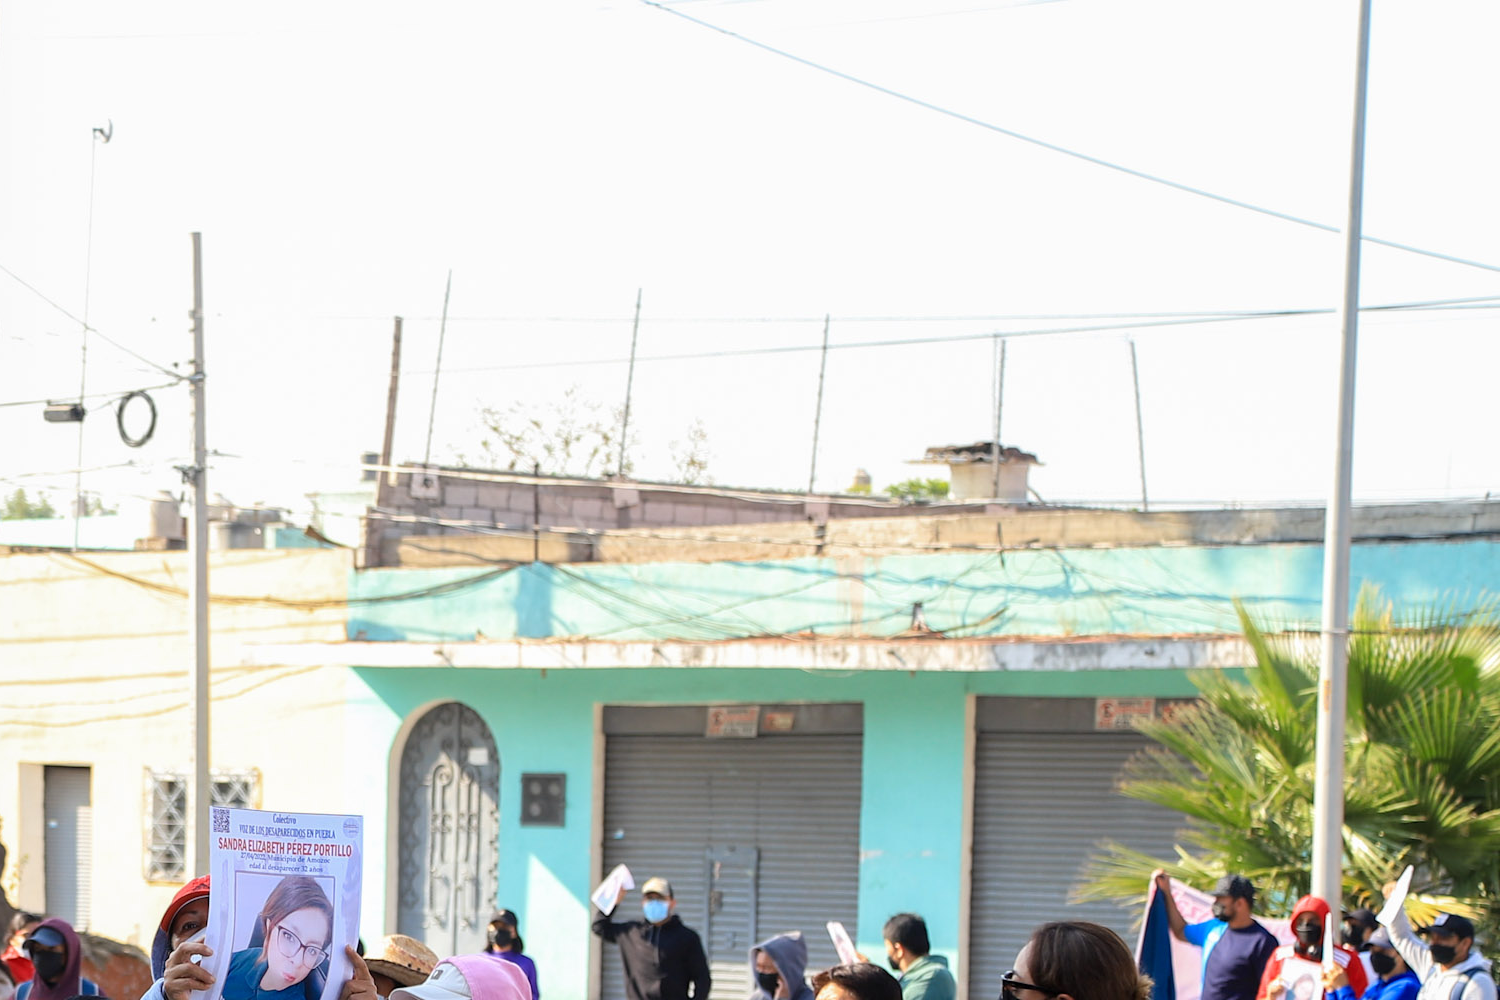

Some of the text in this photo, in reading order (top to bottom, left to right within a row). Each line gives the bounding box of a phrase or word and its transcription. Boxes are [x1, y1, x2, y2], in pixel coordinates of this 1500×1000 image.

[272, 813, 297, 824] Colectivo
[239, 824, 336, 840] VOZ DE LOS DESAPARECIDOS EN PUEBLA
[218, 836, 352, 857] SANDRA ELIZABETH PÉREZ PORTILLO
[267, 854, 296, 864] Municipio
[297, 856, 305, 864] de
[268, 864, 300, 873] desaparecer
